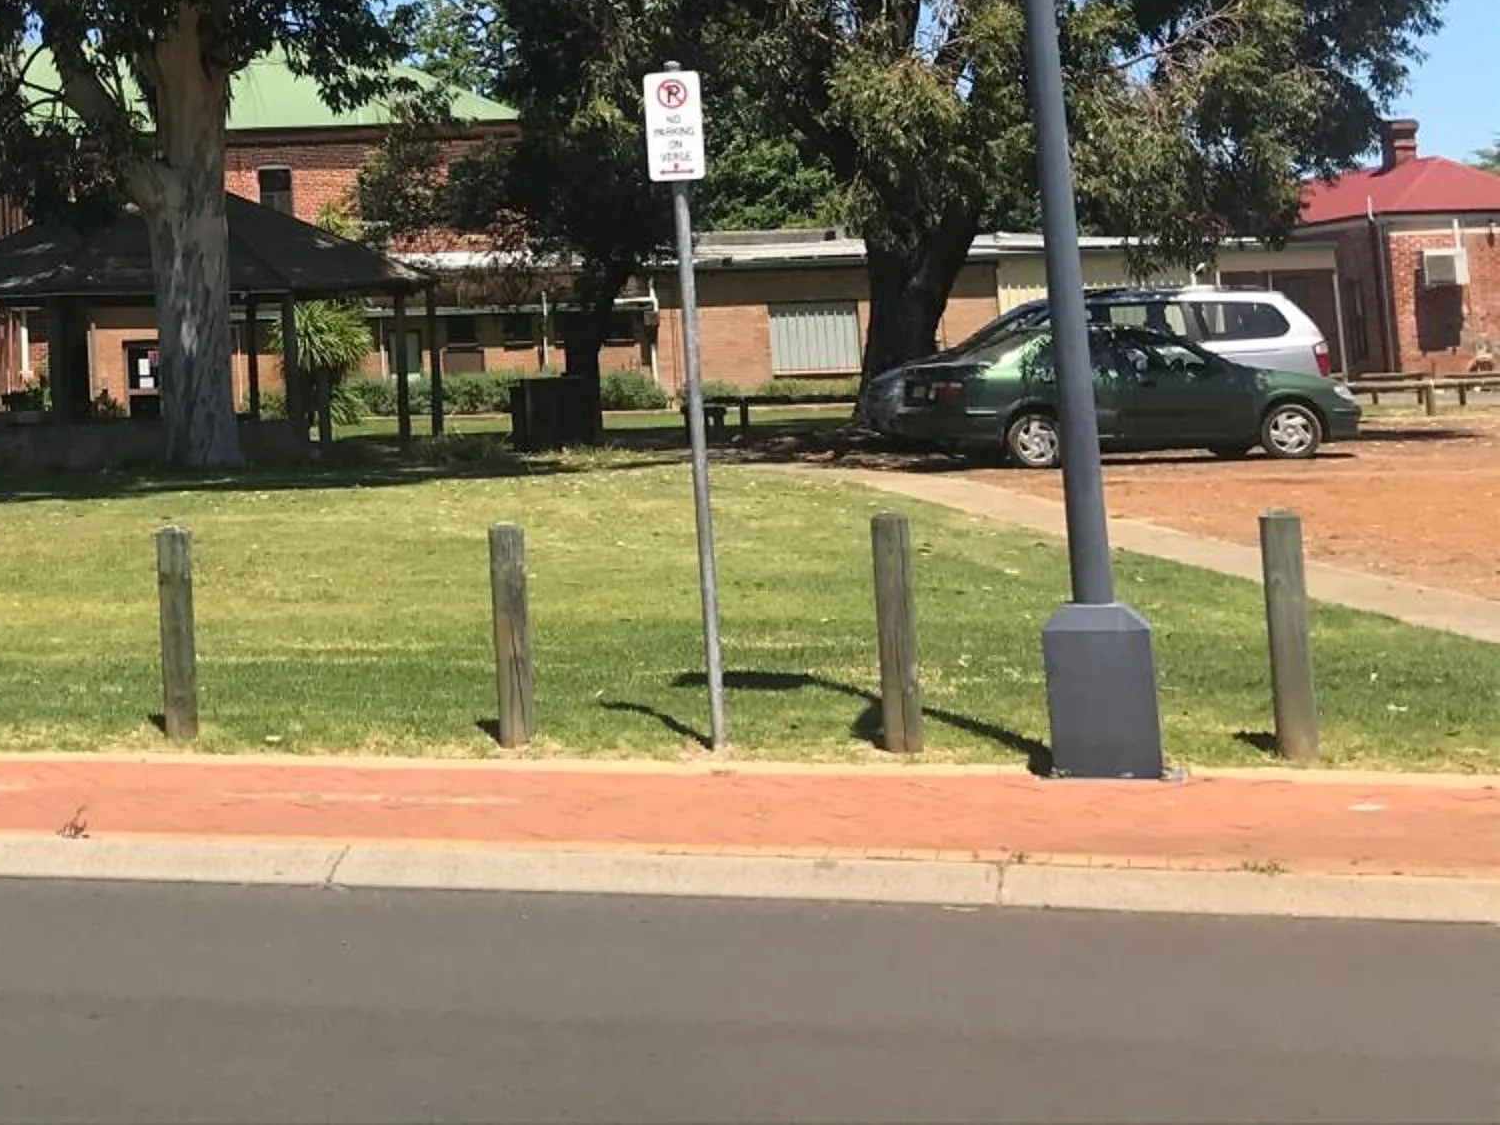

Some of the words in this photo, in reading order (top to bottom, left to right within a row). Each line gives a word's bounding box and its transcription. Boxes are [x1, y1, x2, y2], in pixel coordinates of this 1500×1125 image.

[666, 115, 681, 124] NO
[653, 127, 695, 137] PARKING
[668, 140, 683, 149] ON
